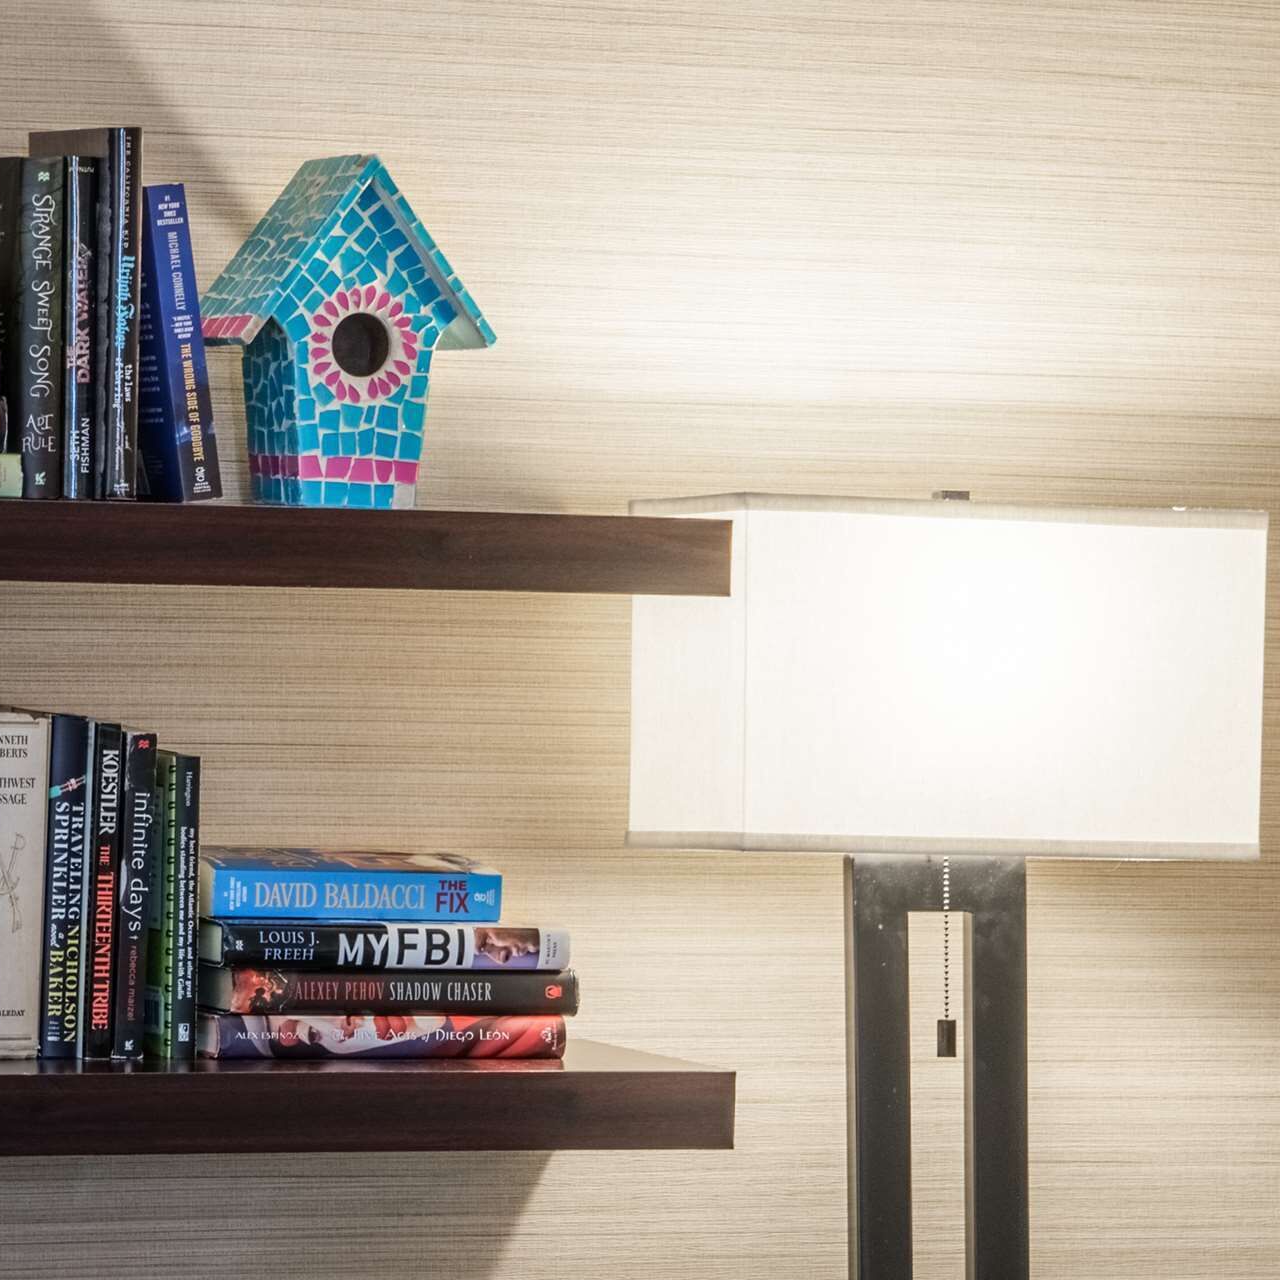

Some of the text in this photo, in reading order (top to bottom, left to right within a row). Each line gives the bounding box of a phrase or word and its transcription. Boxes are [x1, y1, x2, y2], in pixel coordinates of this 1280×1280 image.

[167, 231, 181, 270] MICHAEL
[28, 193, 57, 400] STRANGE SWEET SONG
[171, 271, 187, 311] CONNELLY
[76, 327, 91, 384] DARK
[180, 342, 192, 359] THE
[183, 360, 196, 391] WRONG
[186, 391, 199, 411] SIDE
[25, 413, 54, 435] ADI
[188, 411, 200, 423] OF
[22, 433, 56, 455] RULE
[80, 417, 90, 474] FISHMAN
[190, 424, 206, 463] GOODBYE
[51, 801, 70, 920] SPRINKLER
[68, 802, 84, 920] TRAVELING
[122, 792, 153, 931] infinite days
[91, 749, 119, 1030] KOESTLER THE THIRTEENTH TRIBE
[254, 882, 318, 908] DAVID
[324, 883, 425, 909] BALDACCI
[438, 880, 467, 891] THE
[435, 892, 469, 913] FIX
[259, 931, 320, 945] LOUIS J.
[263, 948, 314, 961] FREEH
[47, 950, 64, 1017] BAKER
[63, 925, 80, 1042] NICHOLSON
[295, 982, 492, 1001] ALEXEY PEHOV SHADOW CHASER
[235, 1028, 510, 1043] ALEX ACTS DIEGO LEÓN
